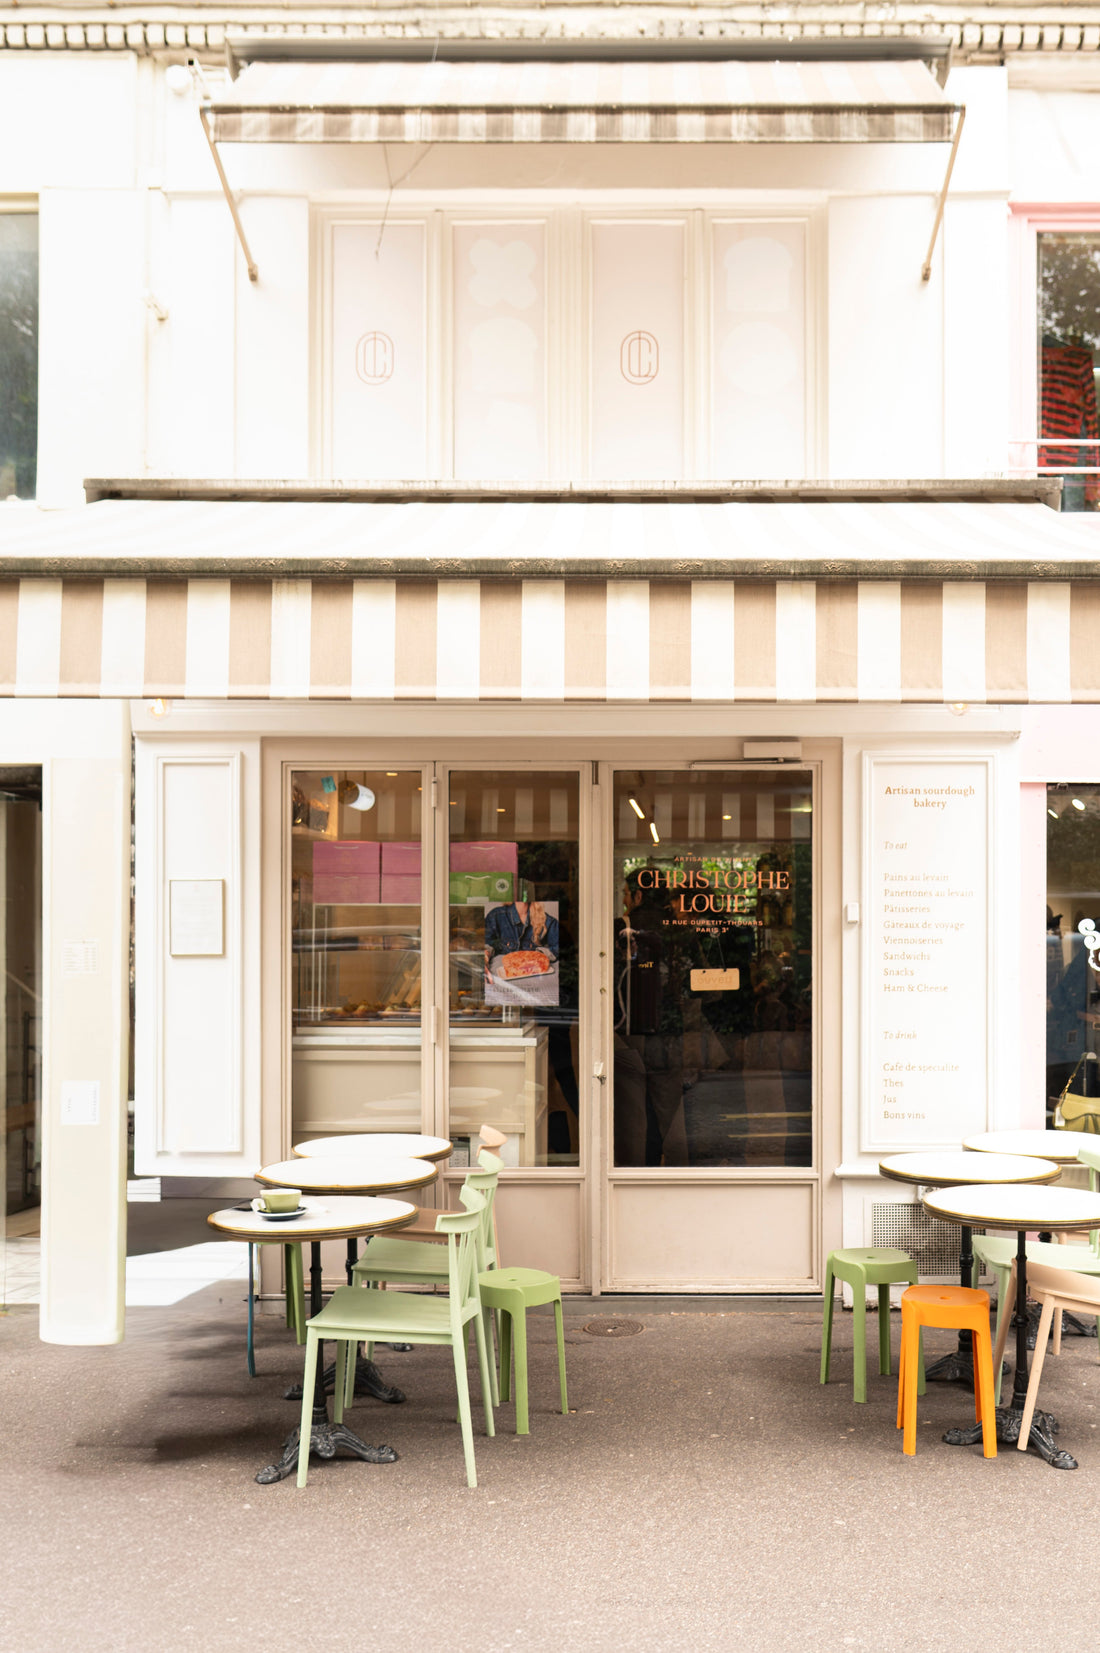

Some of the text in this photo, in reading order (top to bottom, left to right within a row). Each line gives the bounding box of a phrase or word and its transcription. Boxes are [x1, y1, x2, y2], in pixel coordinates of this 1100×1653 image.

[885, 786, 975, 798] Artisan sourdough
[914, 798, 947, 810] bakery
[884, 841, 908, 850] To eat
[637, 870, 790, 890] CHRISTOPHE
[884, 872, 908, 881] Pains
[922, 872, 949, 881] levain
[884, 888, 974, 897] Panettones au levain
[679, 893, 747, 913] LOUIE
[884, 903, 931, 913] Pâtisseries
[921, 919, 932, 929] de
[934, 921, 965, 931] voyage
[883, 936, 944, 945] Viennoiseries
[883, 967, 915, 976] Snacks
[883, 983, 949, 992] Ham & Cheese
[883, 1030, 917, 1040] To drink
[905, 1062, 916, 1072] de
[882, 1094, 897, 1104] Jus
[883, 1110, 926, 1119] Bons vins
